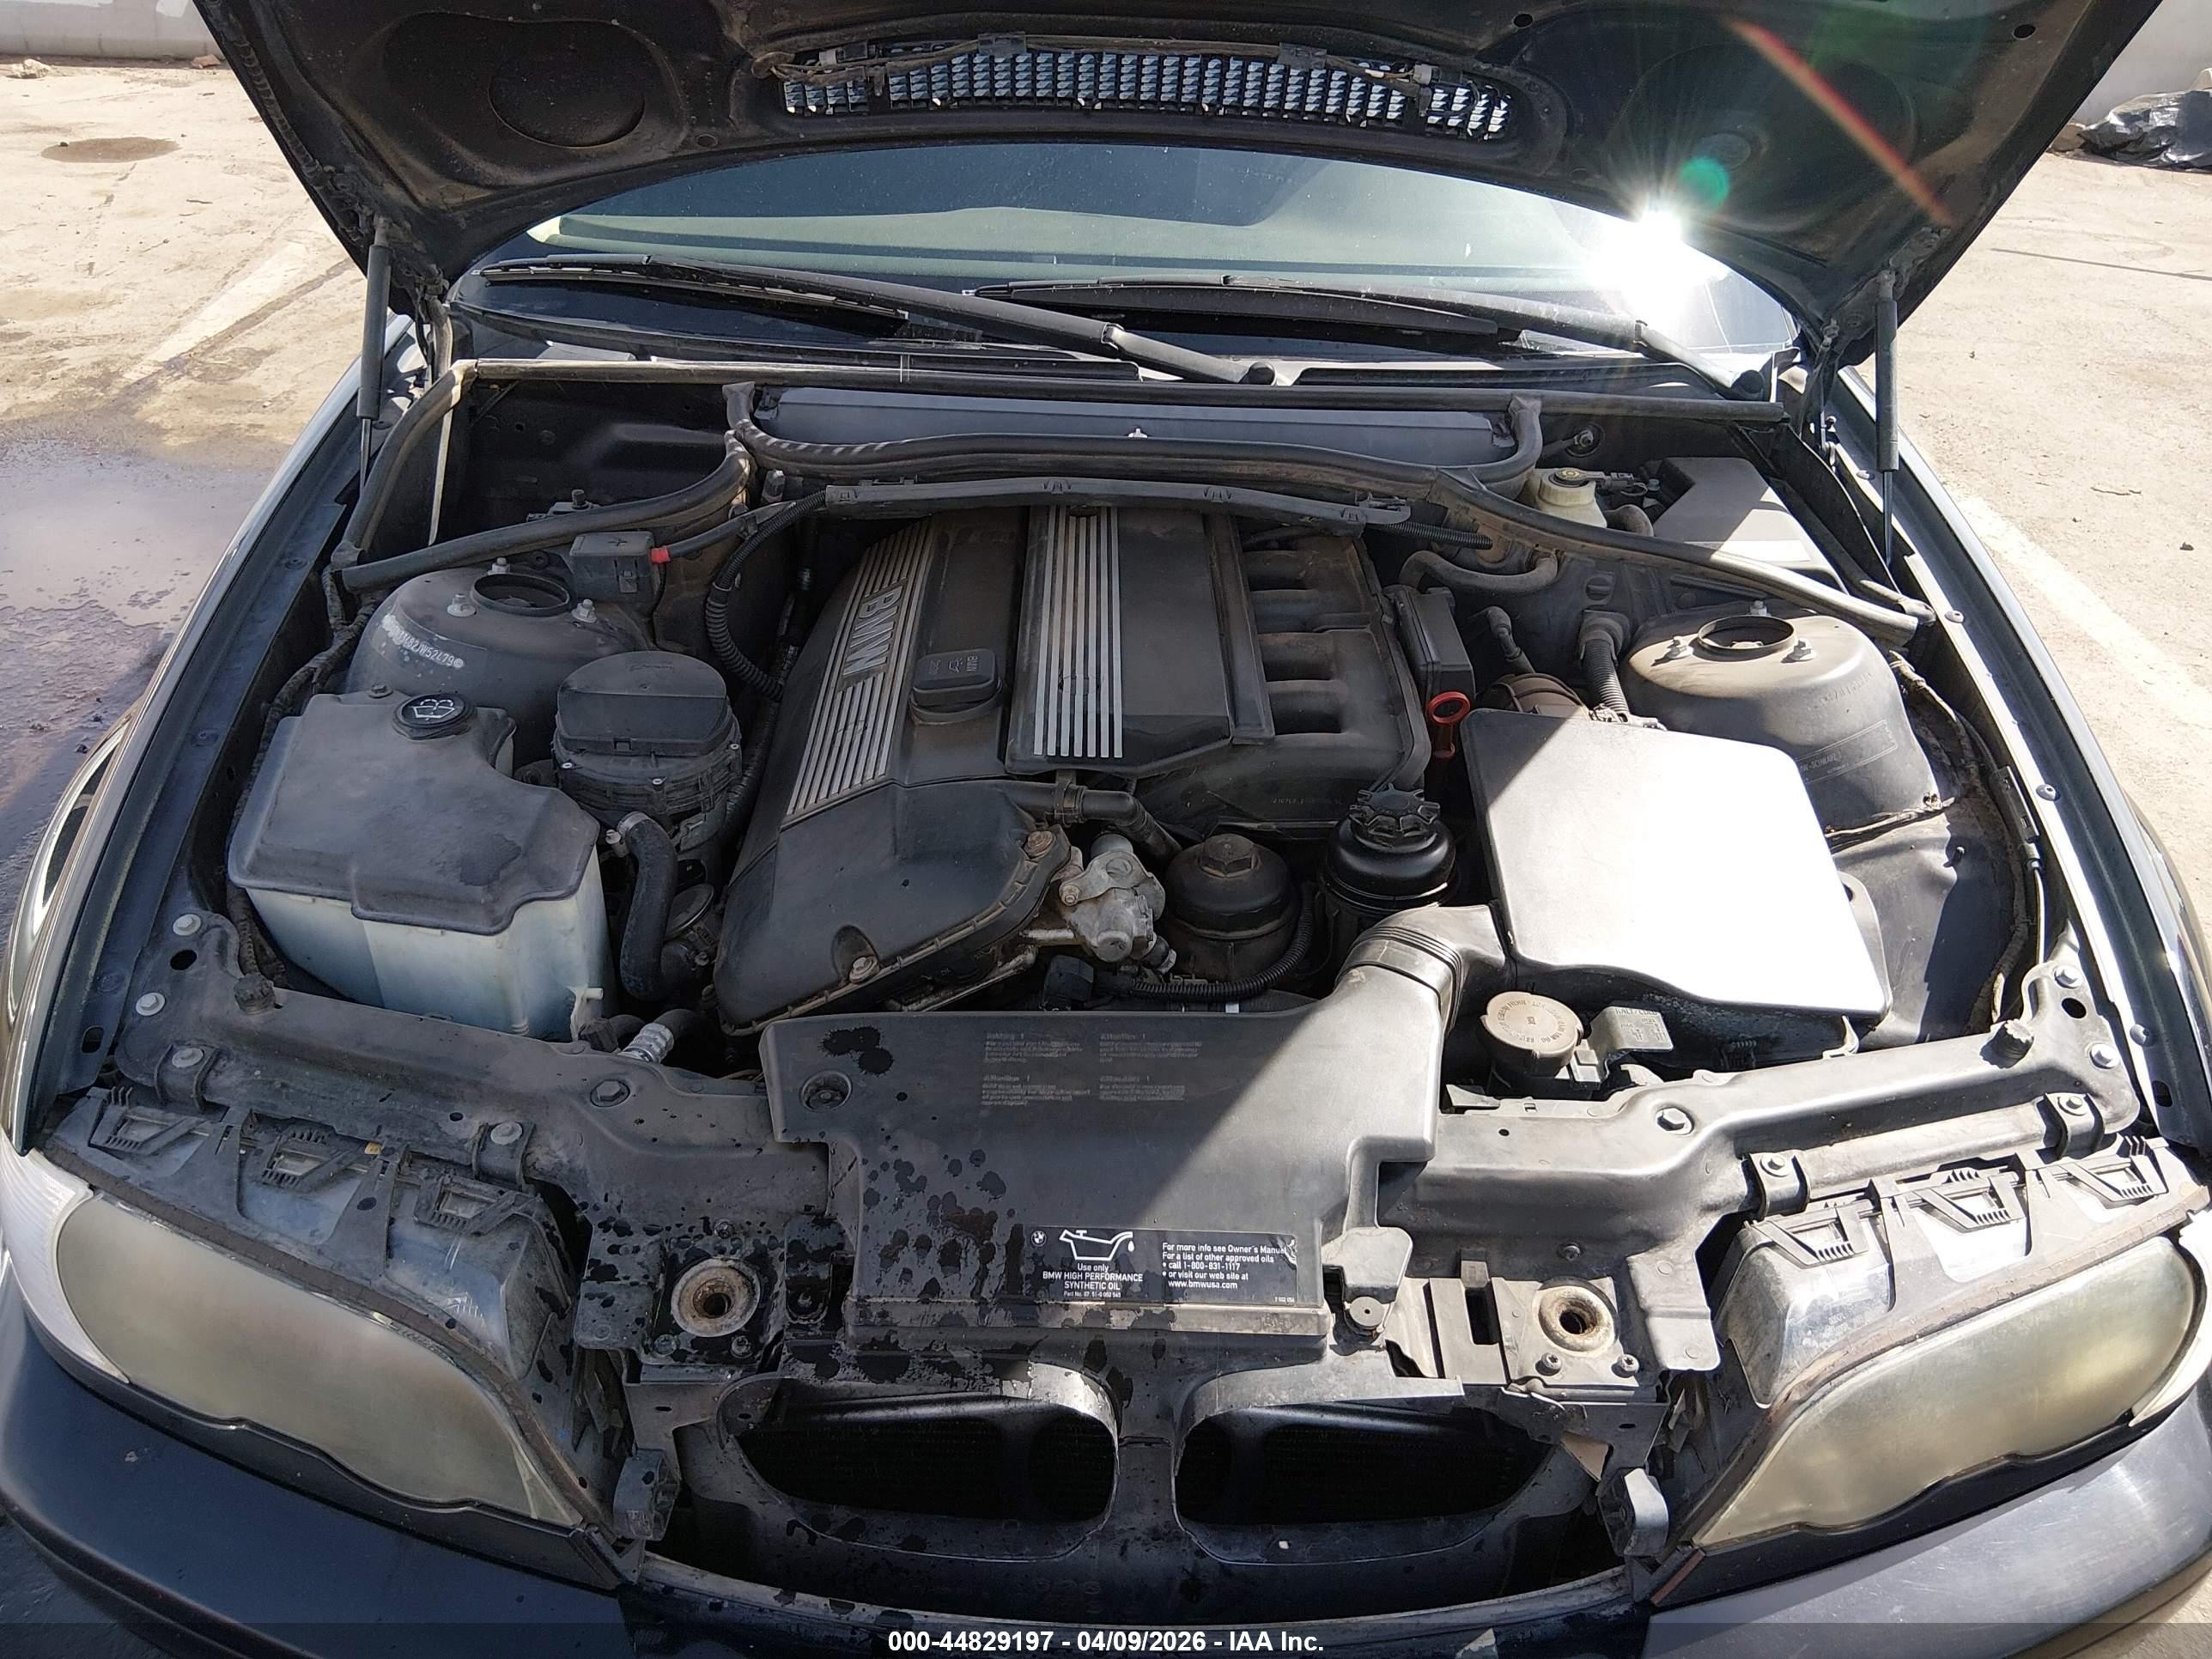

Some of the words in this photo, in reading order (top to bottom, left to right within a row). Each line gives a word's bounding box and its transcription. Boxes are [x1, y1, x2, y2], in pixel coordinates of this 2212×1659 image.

[842, 585, 902, 677] BMW
[1162, 1243, 1174, 1251] For
[1198, 1243, 1211, 1252] info
[1162, 1251, 1174, 1260] For
[1182, 1252, 1194, 1261] list
[1195, 1252, 1203, 1261] of
[1204, 1253, 1224, 1261] other
[1225, 1254, 1259, 1264] approved
[1261, 1255, 1274, 1263] oils
[1077, 1262, 1091, 1271] Use
[1093, 1263, 1109, 1273] only
[1183, 1261, 1241, 1271] 1-800-831-1117
[1064, 1272, 1083, 1280] HIGH
[1085, 1273, 1144, 1282] PERFORMANCE
[1209, 1271, 1224, 1279] web
[1241, 1272, 1249, 1280] at
[1065, 1280, 1106, 1290] SYNTHETIC
[1108, 1282, 1121, 1291] OIL
[1168, 1279, 1238, 1289] www.bmwusa.com
